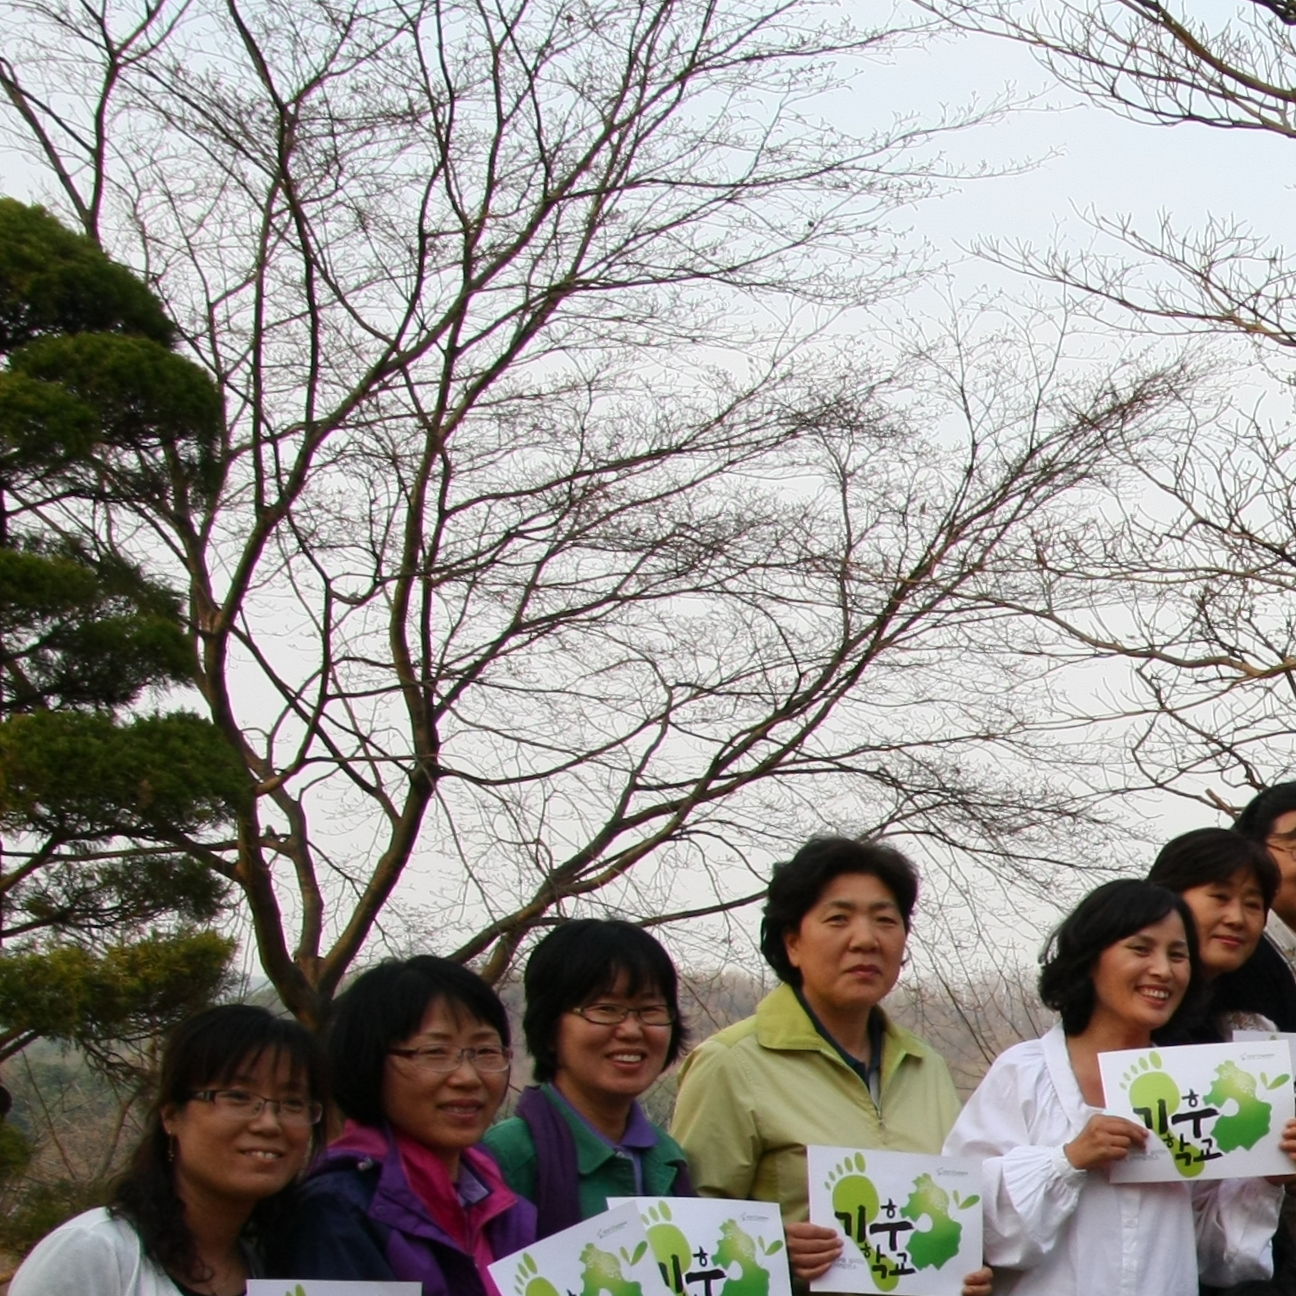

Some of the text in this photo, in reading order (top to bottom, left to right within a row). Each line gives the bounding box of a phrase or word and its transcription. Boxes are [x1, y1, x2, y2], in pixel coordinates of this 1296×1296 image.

[1133, 1089, 1218, 1139] 기후
[1164, 1132, 1223, 1165] 학교
[834, 1198, 914, 1251] 기후
[860, 1245, 916, 1279] 학교
